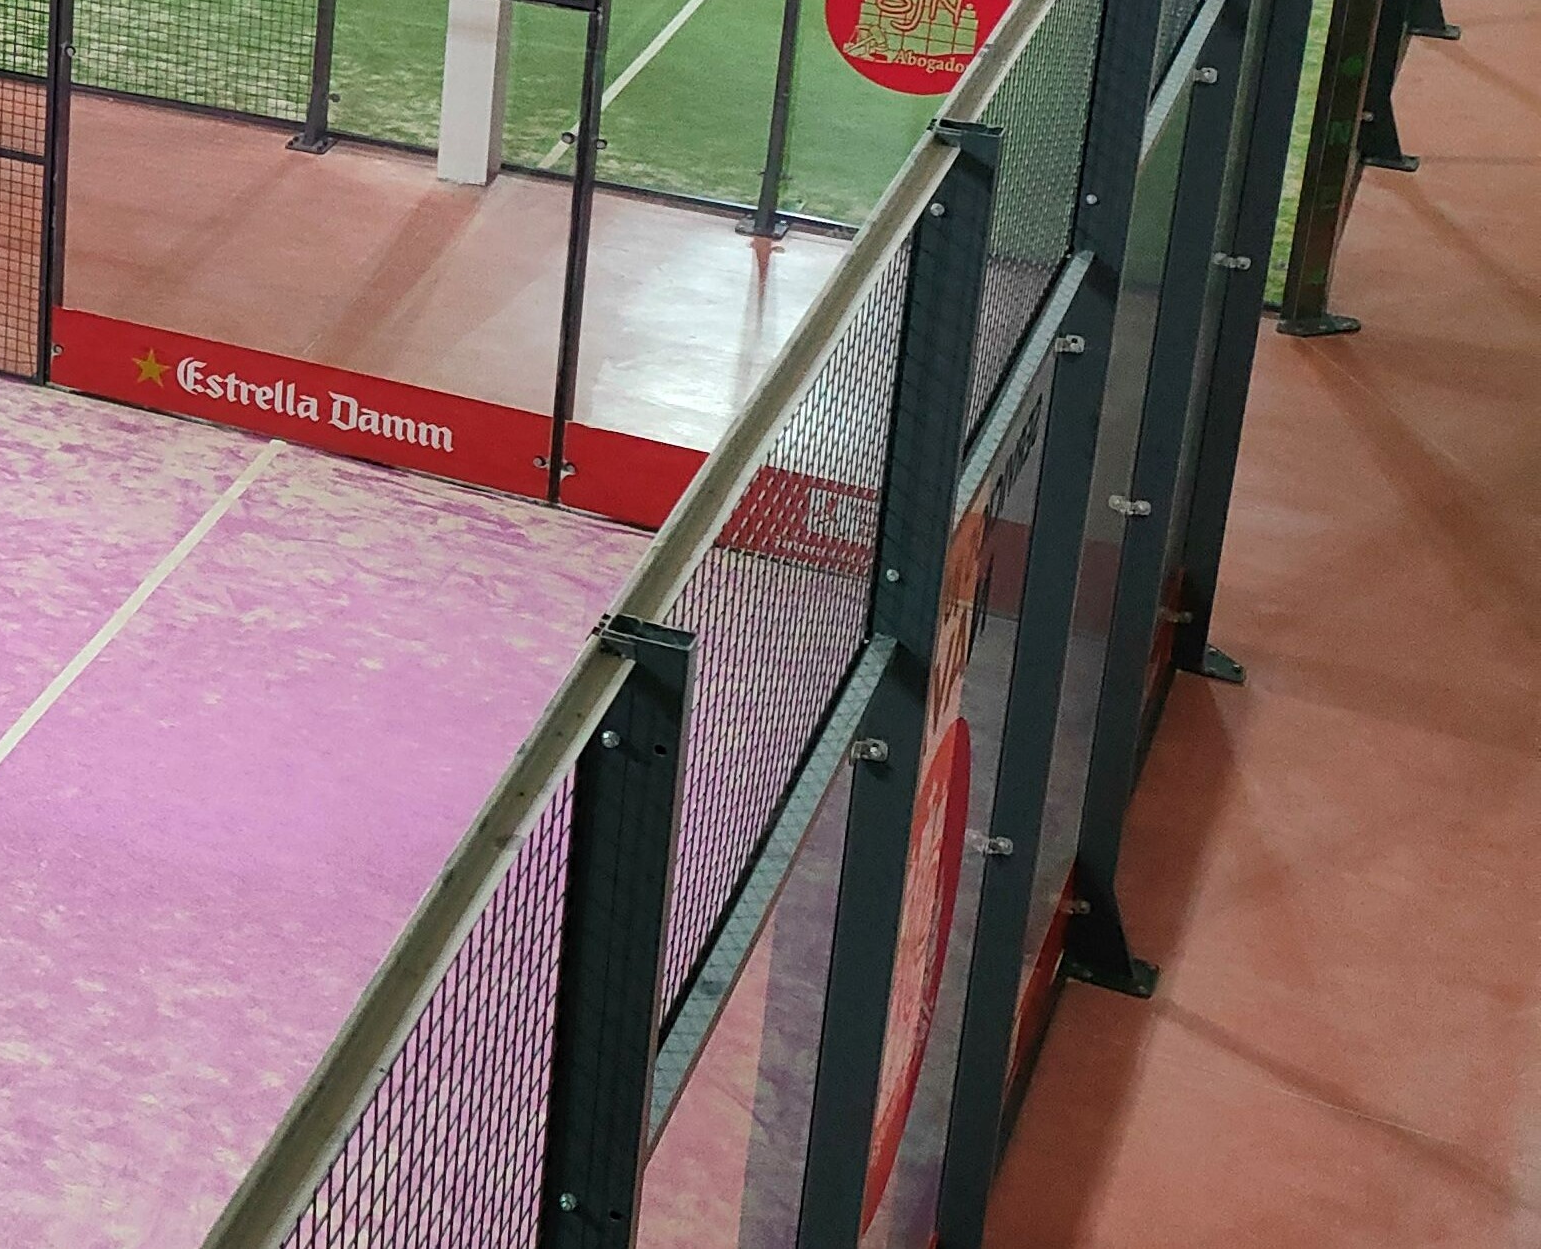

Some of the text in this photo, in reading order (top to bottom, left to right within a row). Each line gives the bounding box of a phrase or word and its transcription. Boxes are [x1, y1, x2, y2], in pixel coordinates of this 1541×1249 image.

[895, 48, 969, 74] Abogado
[176, 356, 454, 453] Estrella Damm
